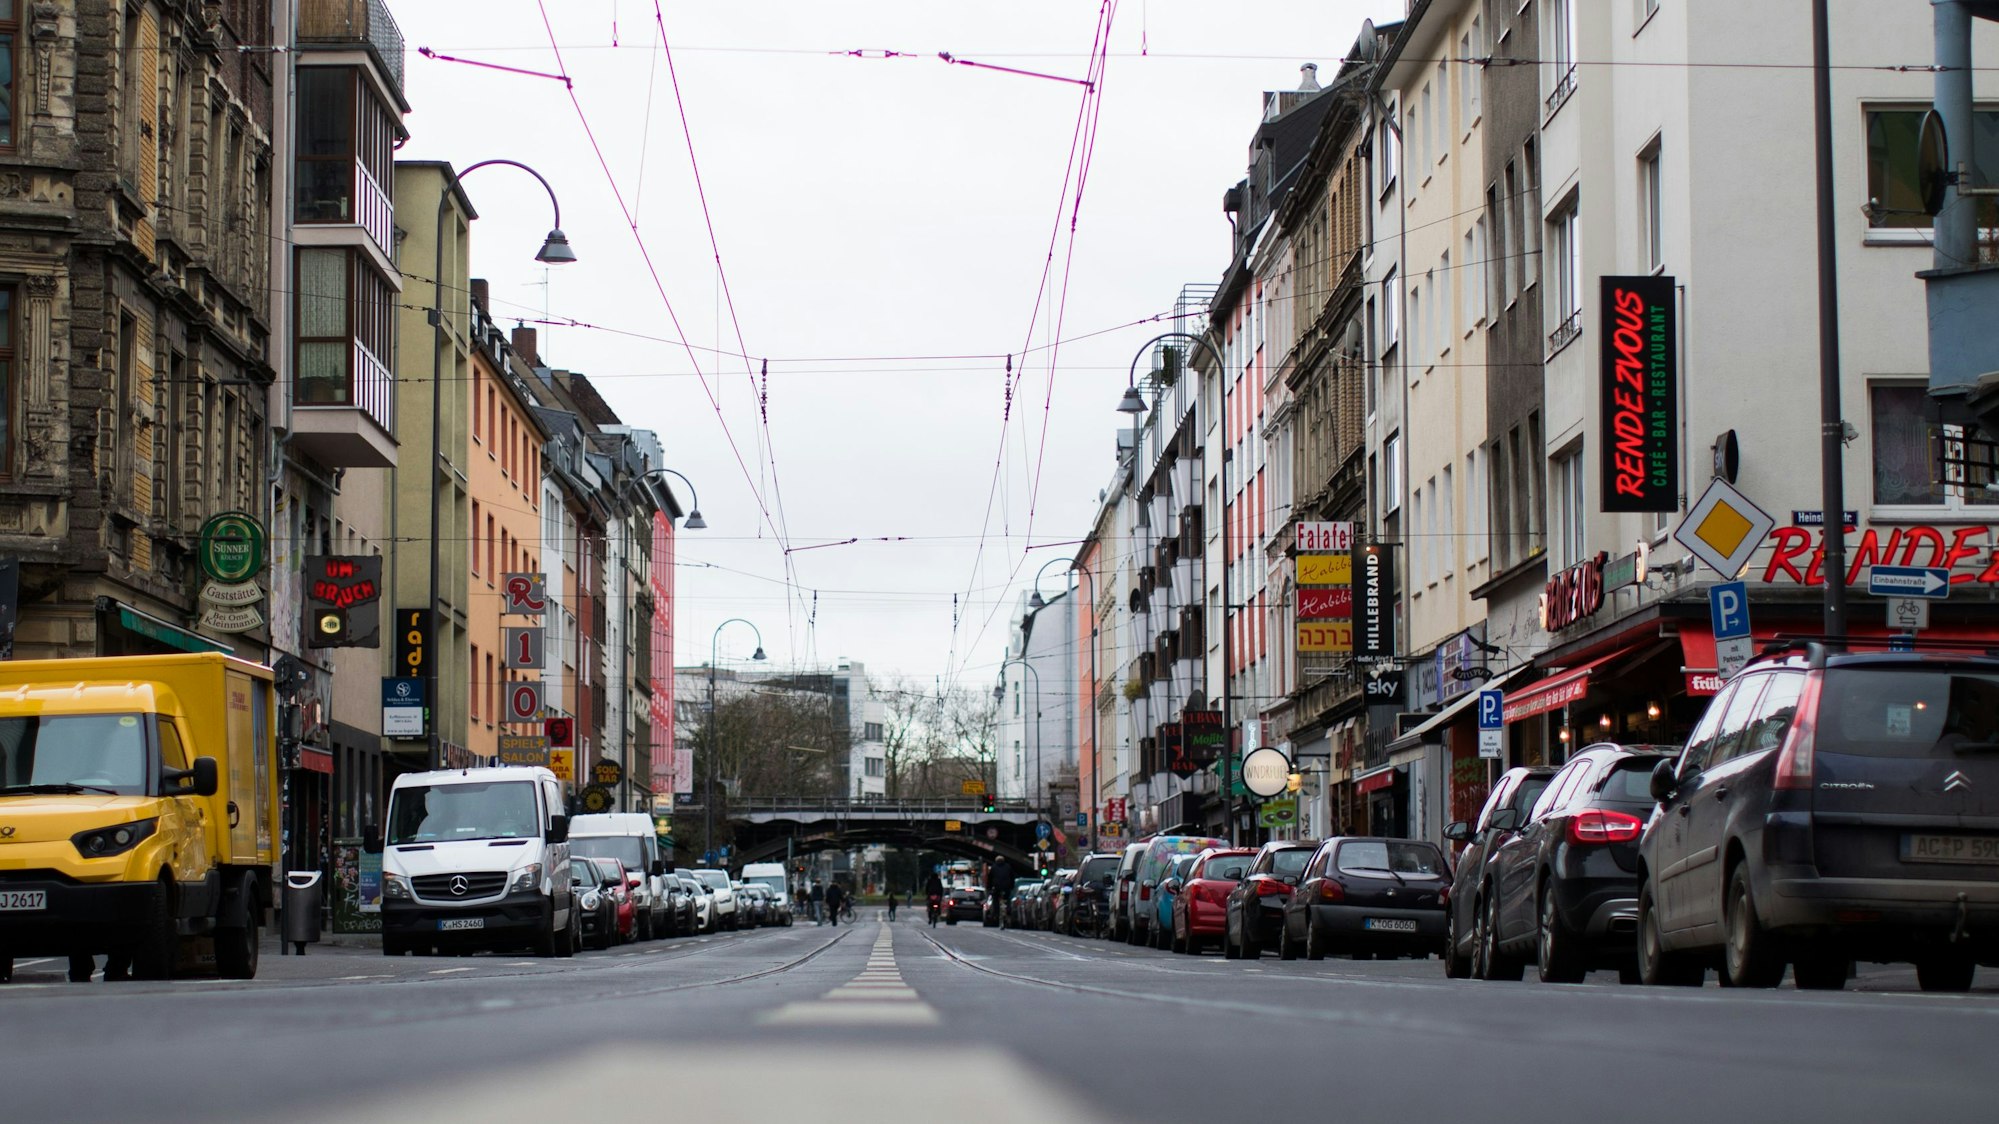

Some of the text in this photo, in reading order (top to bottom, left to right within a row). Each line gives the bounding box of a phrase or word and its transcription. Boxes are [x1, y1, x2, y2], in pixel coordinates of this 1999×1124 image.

[1613, 288, 1645, 498] RENDEZVOUS
[1649, 304, 1667, 487] CAFÉ BAR RESTAURANT
[1298, 523, 1354, 550] Falafel
[1762, 525, 1999, 587] RENDE
[1300, 557, 1352, 581] Habibi
[1873, 575, 1927, 587] Einbahnstraße
[206, 586, 256, 601] Gaststätte
[314, 580, 376, 606] BRUCH
[1299, 592, 1352, 616] Habibi
[1366, 554, 1380, 650] HILLEBRAND
[213, 612, 249, 622] Bei Oma
[1718, 590, 1739, 632] P
[204, 616, 257, 630] Kleinmann
[1367, 678, 1399, 698] sky
[1692, 676, 1725, 691] früh
[1482, 695, 1496, 724] P
[502, 739, 537, 749] SPIEL
[502, 752, 545, 763] SALON
[596, 766, 620, 774] SOUL
[598, 774, 617, 783] BAR
[1917, 838, 1940, 856] AC
[1953, 840, 1963, 857] P
[11, 893, 44, 908] 2617
[442, 919, 483, 929] K HS 2460
[1371, 919, 1377, 928] K
[1394, 920, 1415, 929] 6060
